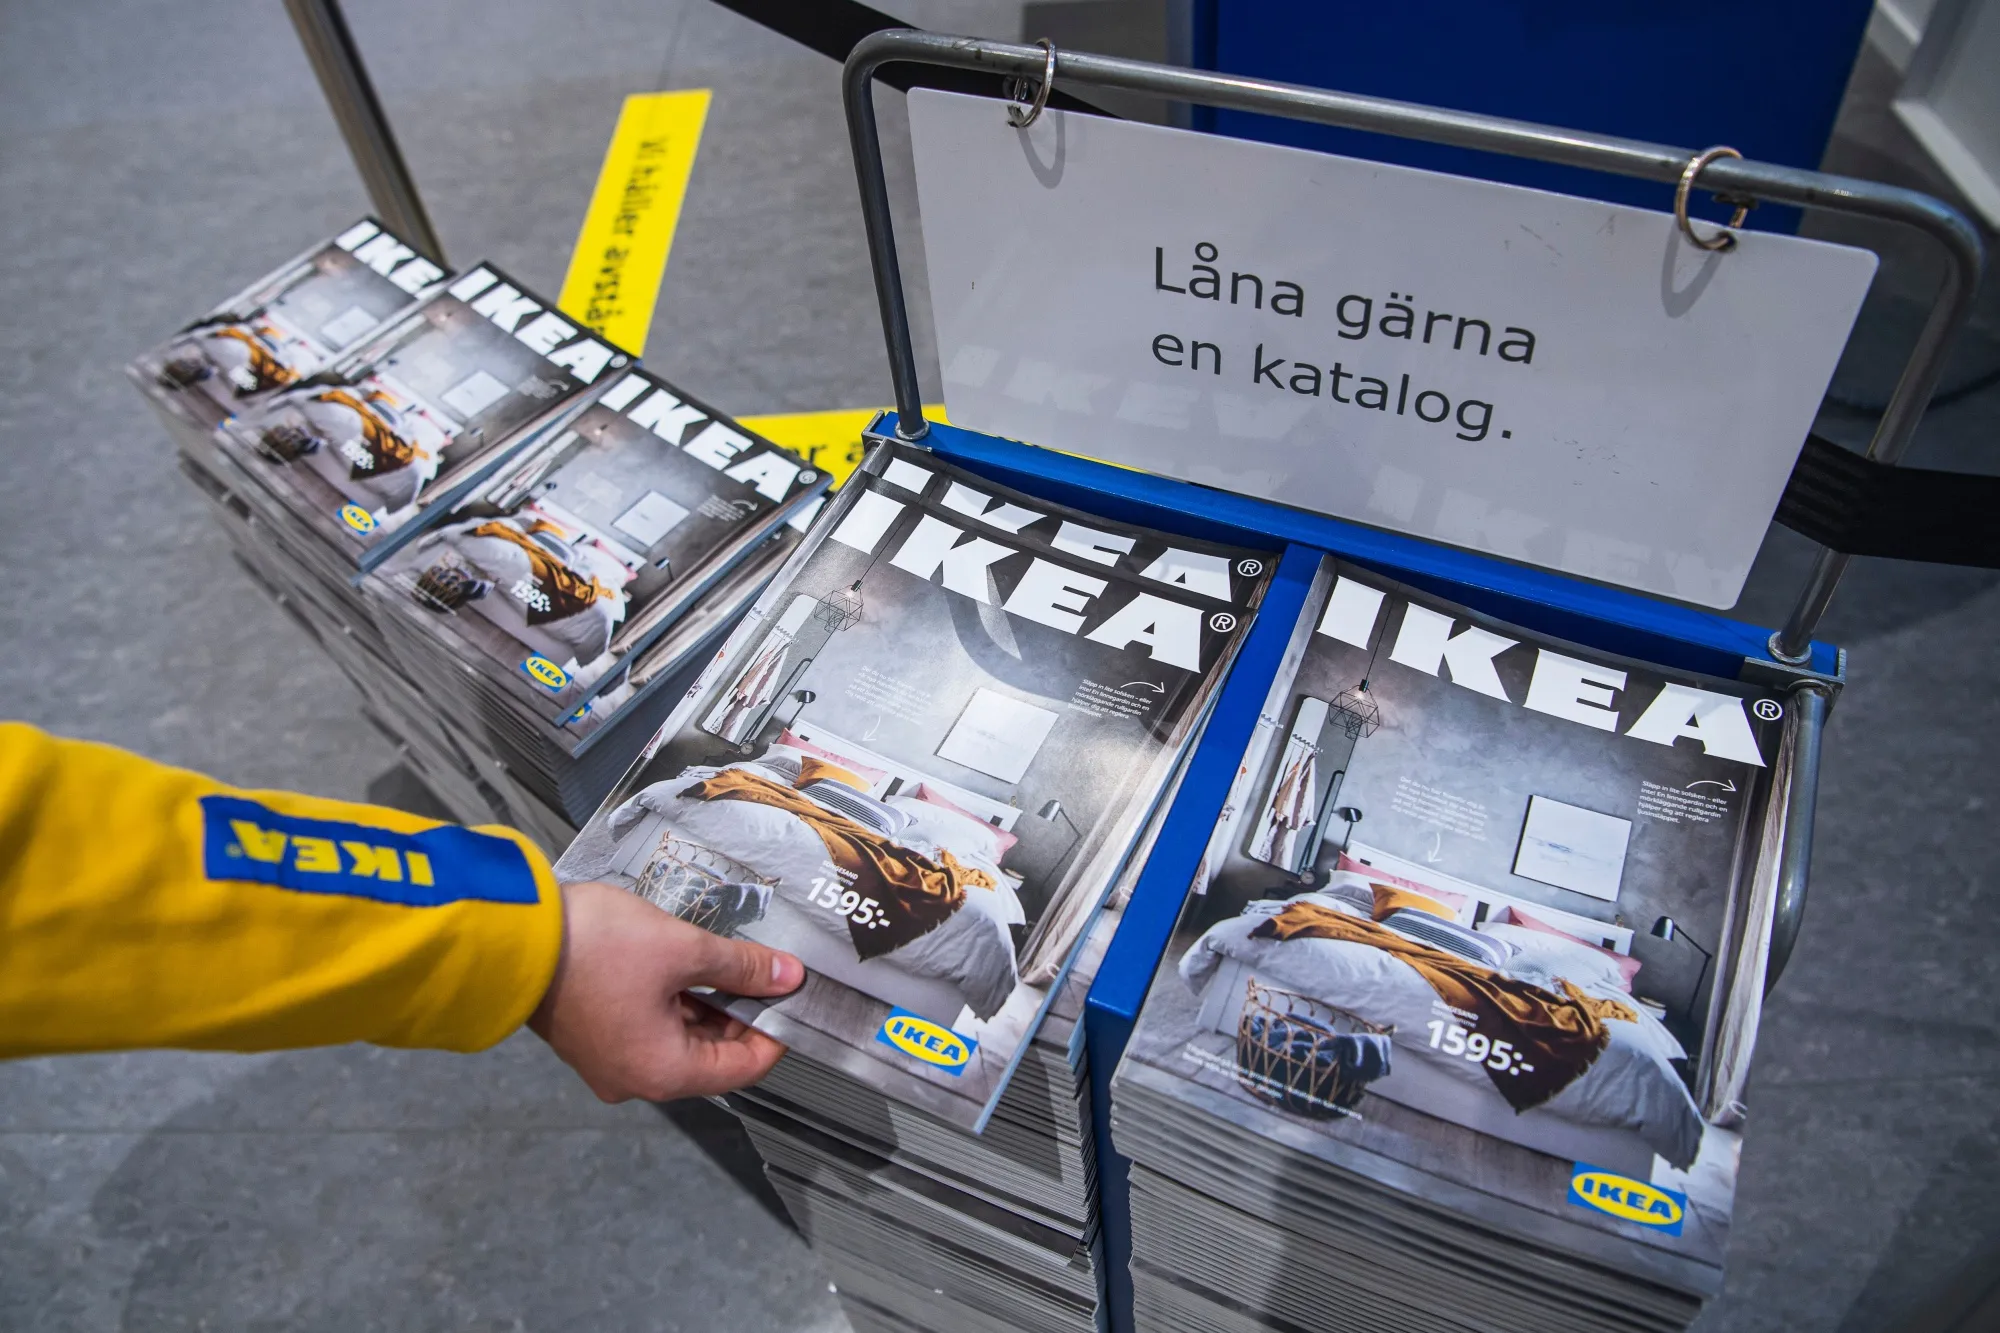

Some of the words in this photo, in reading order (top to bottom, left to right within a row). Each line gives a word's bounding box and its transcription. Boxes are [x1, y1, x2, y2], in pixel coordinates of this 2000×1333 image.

[335, 220, 450, 301] IKE
[1154, 242, 1305, 318] Låna
[1336, 292, 1537, 365] gärna
[1151, 331, 1222, 376] en
[1253, 343, 1512, 442] katalog.
[807, 877, 891, 930] 1595:-
[892, 1021, 961, 1061] IKEA
[1427, 1019, 1535, 1076] 1595:-
[1583, 1178, 1673, 1219] IKEA
